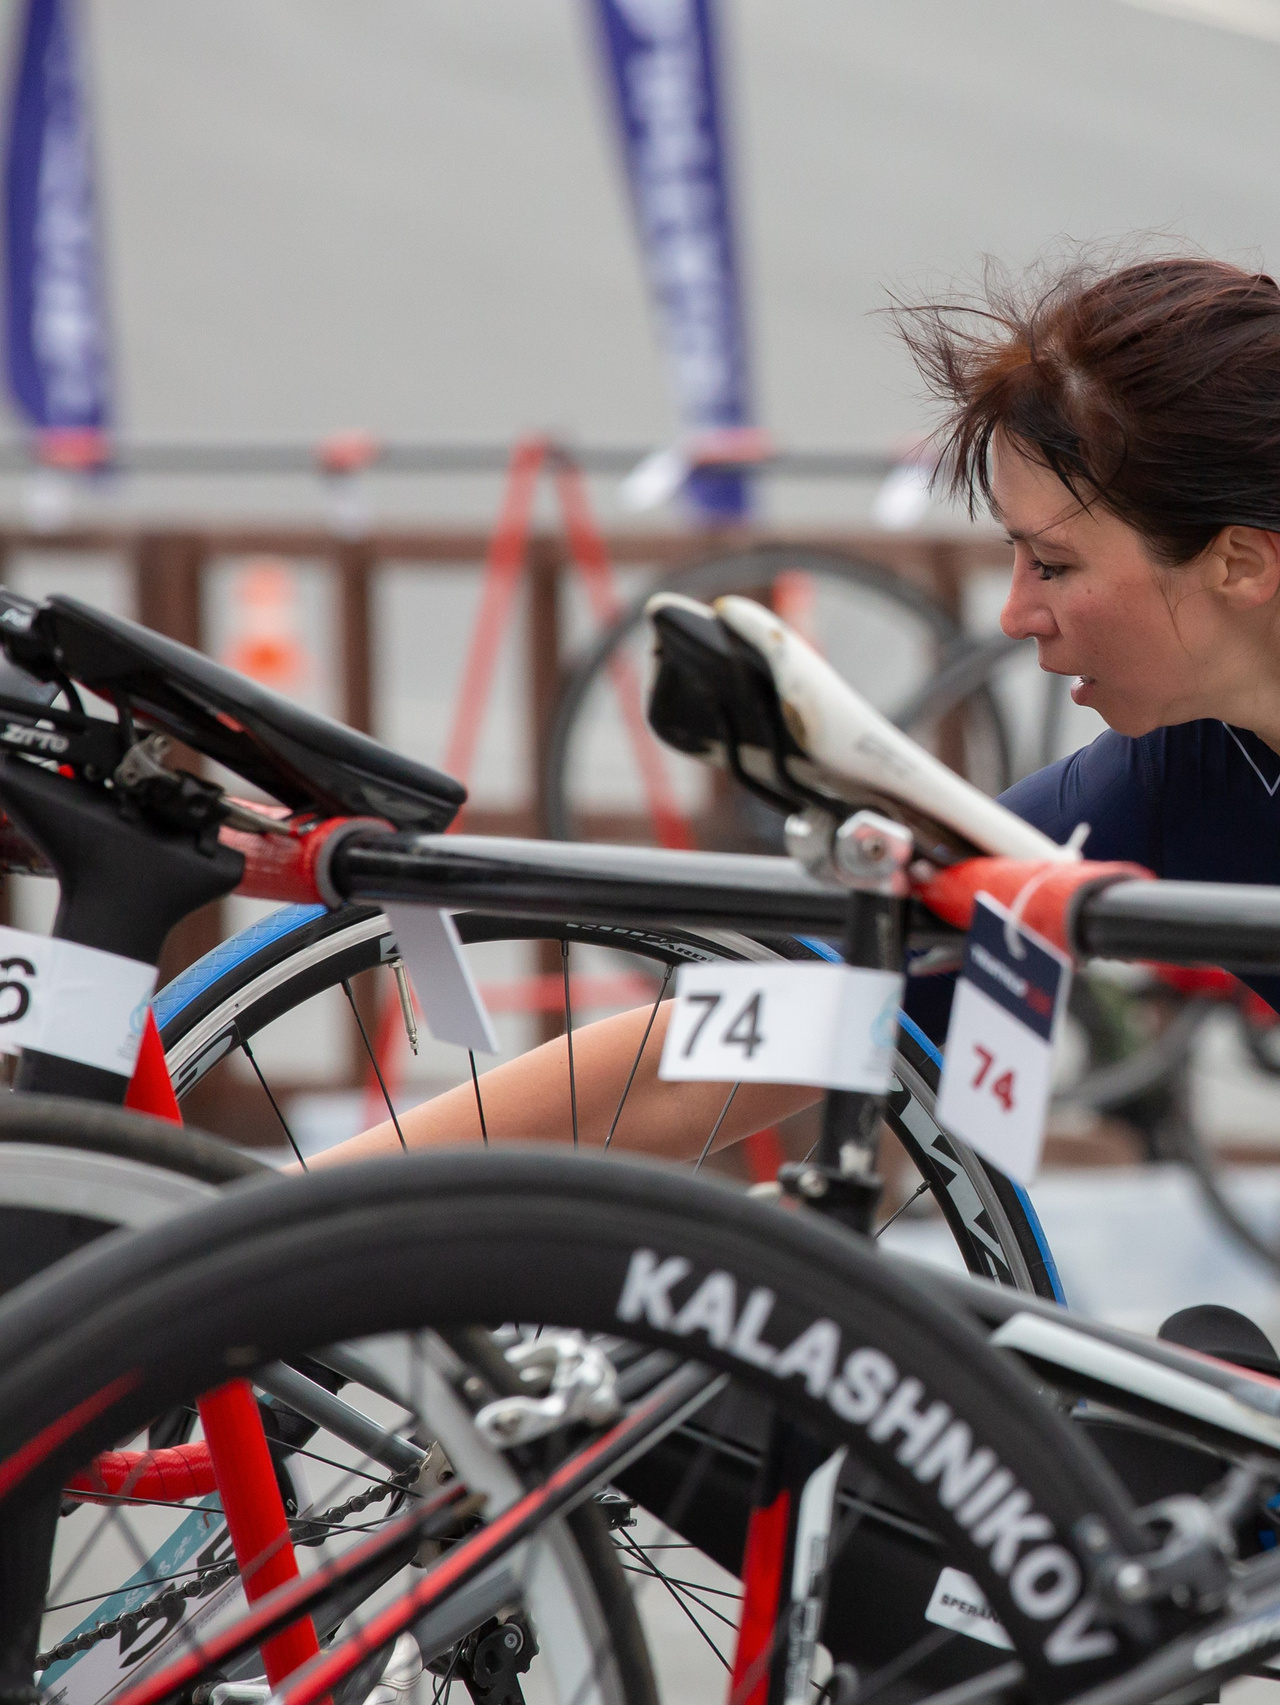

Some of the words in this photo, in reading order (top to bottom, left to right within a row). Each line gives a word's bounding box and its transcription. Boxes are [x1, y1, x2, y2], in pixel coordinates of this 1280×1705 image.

[681, 990, 764, 1059] 74
[971, 1043, 1016, 1112] 74
[616, 1247, 1120, 1666] KALASHNIKOV
